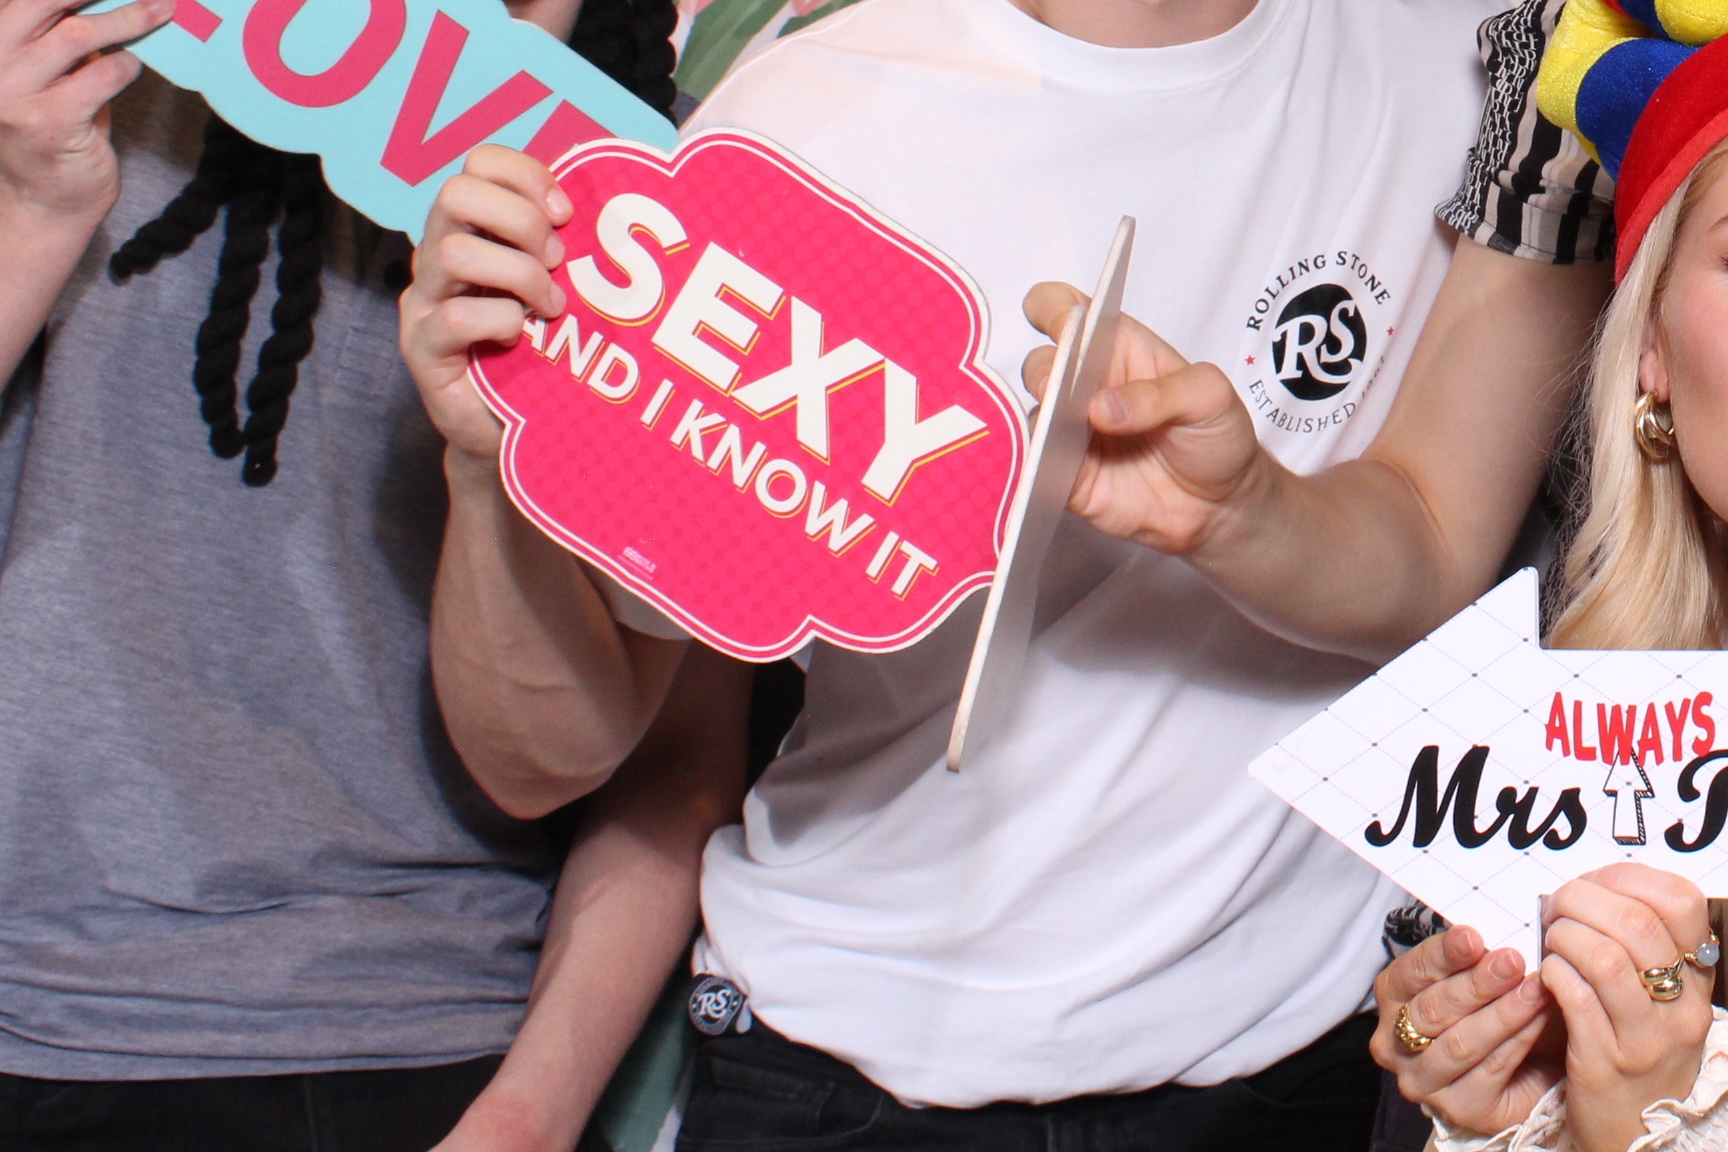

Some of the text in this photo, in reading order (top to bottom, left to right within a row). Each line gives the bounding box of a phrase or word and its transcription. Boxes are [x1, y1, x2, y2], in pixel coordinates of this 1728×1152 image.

[1246, 250, 1391, 332] ROLLING STONE
[566, 192, 990, 507] SEXY
[1272, 298, 1364, 385] RS
[1249, 379, 1357, 434] ESTABLISHED
[639, 378, 676, 431] I
[669, 398, 876, 557] KNOW
[865, 530, 940, 601] IT
[1544, 691, 1717, 767] ALWAYS
[1364, 744, 1588, 850] Mrs
